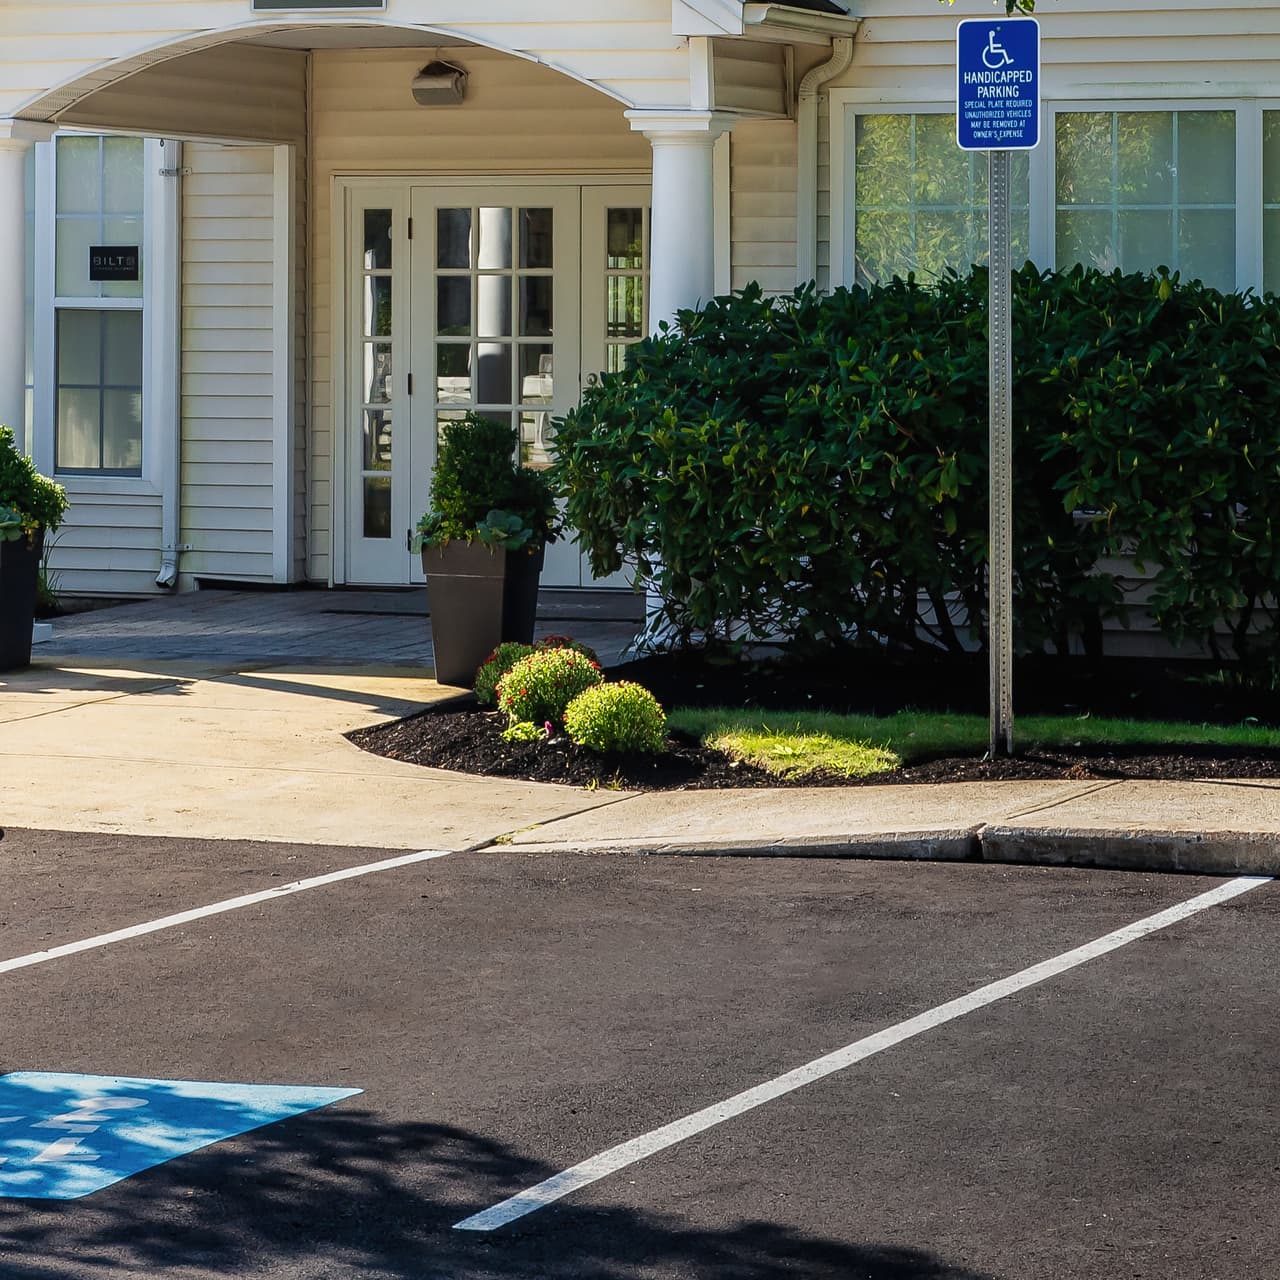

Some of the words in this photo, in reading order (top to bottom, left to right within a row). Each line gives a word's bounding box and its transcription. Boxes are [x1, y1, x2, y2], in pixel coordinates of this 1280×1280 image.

[964, 70, 1033, 84] HANDICAPPED
[978, 85, 1020, 99] PARKING
[964, 100, 986, 109] SPECIAL
[987, 100, 1004, 109] PLATE
[1005, 99, 1033, 108] REQUIRED
[964, 110, 1005, 119] UNAUTHORIZED
[1006, 109, 1032, 118] VEHICLES
[970, 120, 982, 129] MAY
[992, 120, 1018, 128] REMOVED
[973, 130, 998, 139] OWNER'S
[999, 129, 1024, 138] EXPENSE
